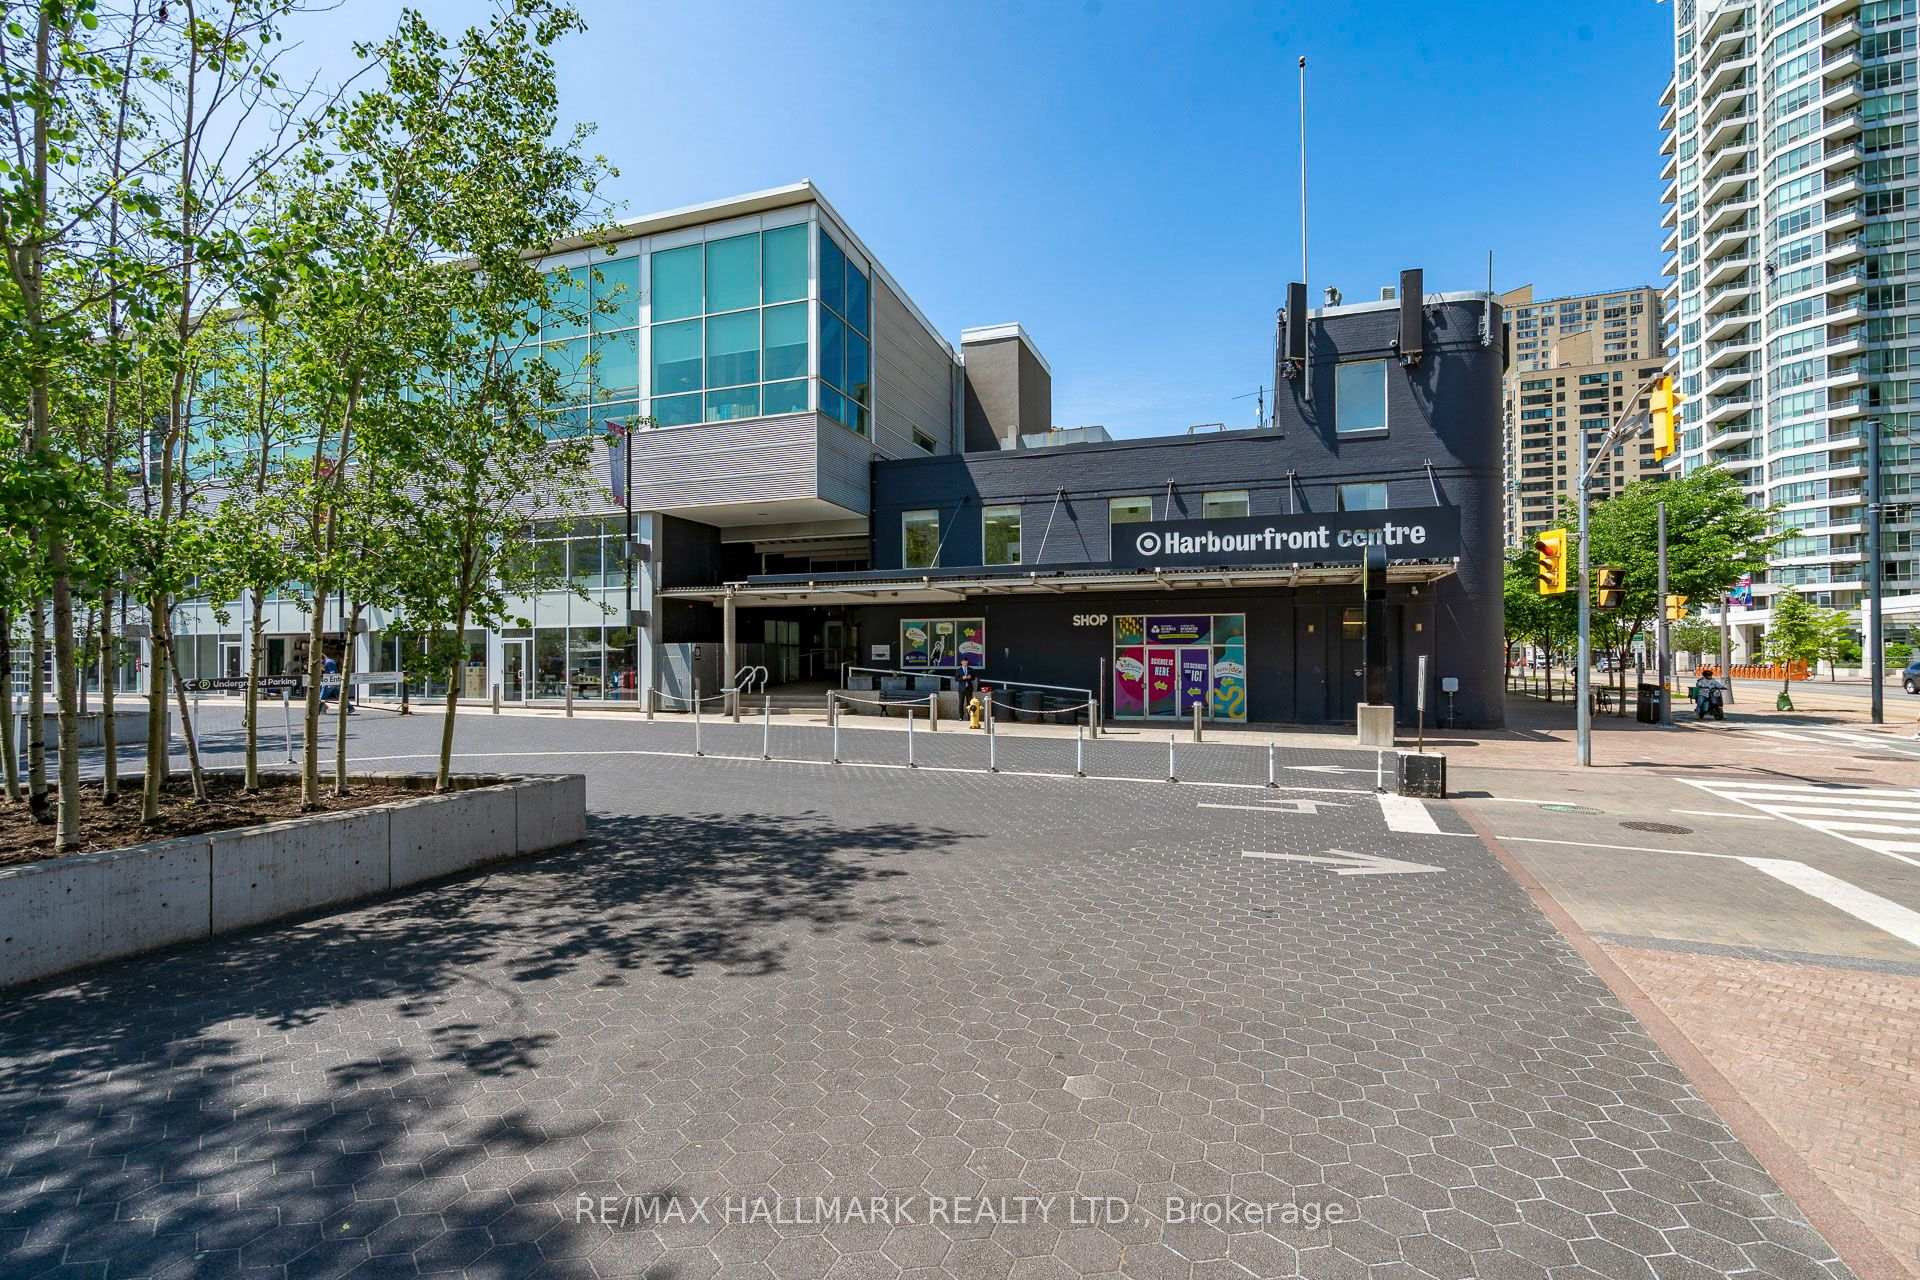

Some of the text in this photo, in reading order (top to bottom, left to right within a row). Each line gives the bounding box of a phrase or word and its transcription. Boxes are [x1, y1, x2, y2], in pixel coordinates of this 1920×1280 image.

[1164, 521, 1426, 555] Harbourfront centre
[1072, 614, 1108, 626] SHOP
[1191, 669, 1203, 682] ICI
[213, 679, 267, 689] Undergrnd
[268, 677, 297, 687] Parking
